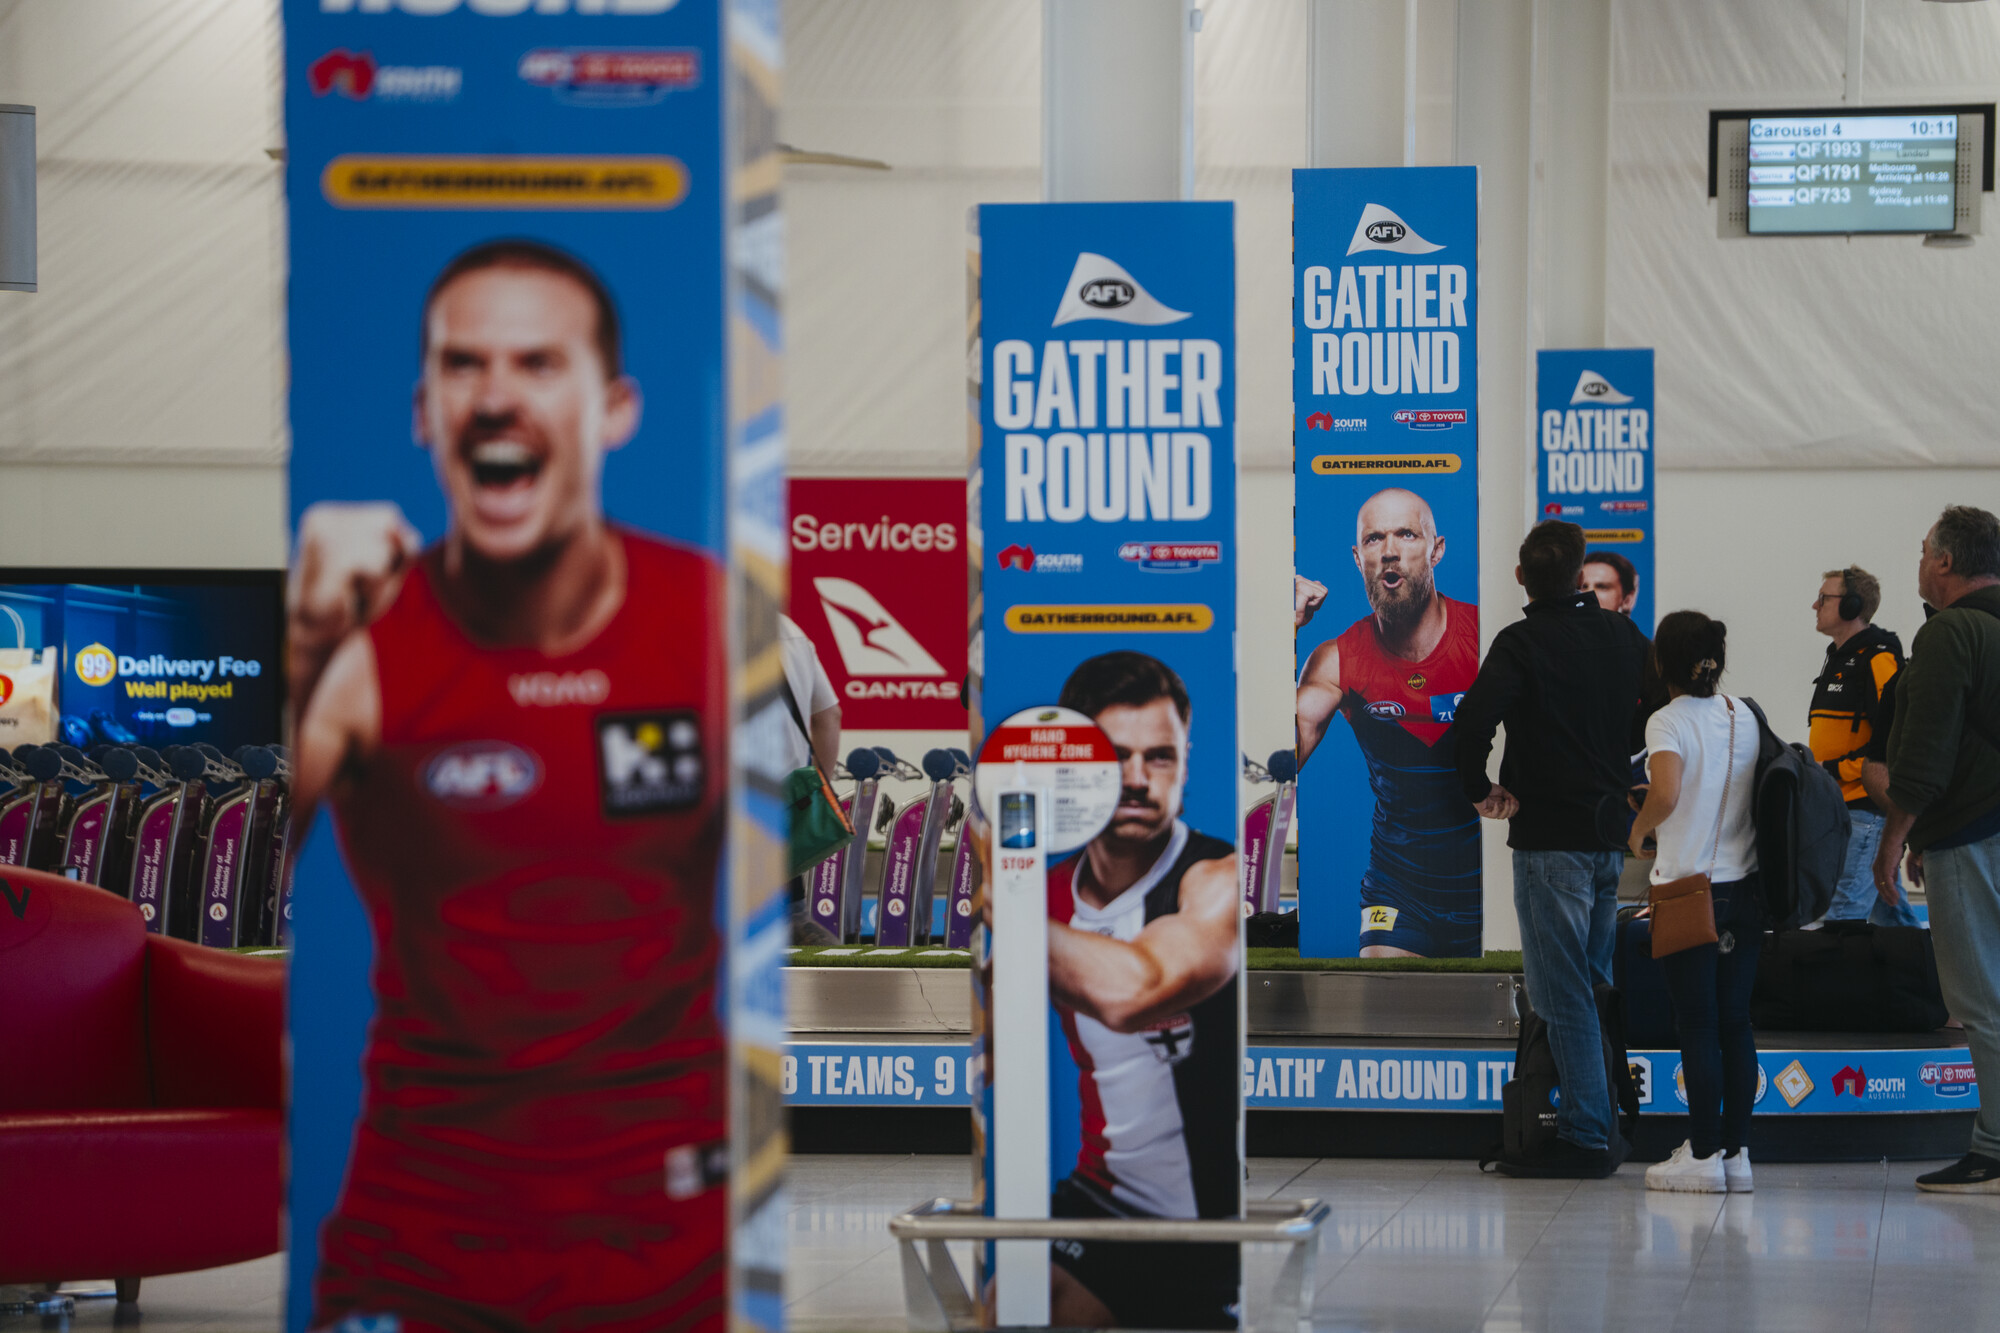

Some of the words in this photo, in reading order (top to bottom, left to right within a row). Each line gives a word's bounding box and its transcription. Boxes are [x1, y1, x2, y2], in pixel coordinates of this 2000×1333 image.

[1751, 122, 1827, 138] Carousel
[1832, 122, 1842, 136] 4
[1909, 120, 1954, 135] 10:11
[1797, 142, 1862, 159] QF1993
[1869, 140, 1903, 151] Sydney
[1897, 149, 1929, 158] Landed
[1796, 164, 1860, 181] QF1791
[1868, 163, 1917, 173] Melbourne
[1874, 173, 1912, 184] Arriving
[1913, 172, 1923, 182] at
[1796, 187, 1852, 205] QF733
[1868, 185, 1903, 196] Sydney
[1874, 195, 1911, 206] Arriving
[1913, 195, 1923, 205] at
[1369, 225, 1403, 239] AFL
[1083, 284, 1131, 303] AFL
[1304, 264, 1468, 329] GATHER
[1312, 331, 1460, 396] ROUND
[993, 338, 1223, 430] GATHER
[1334, 418, 1367, 428] SOUTH
[1394, 412, 1416, 421] AFL
[1432, 412, 1464, 420] TOYOTA
[1542, 408, 1649, 452] GATHER
[1322, 459, 1451, 470] GATHERROUND.AFL
[1548, 450, 1645, 494] ROUND
[1005, 431, 1212, 523] ROUND
[791, 513, 957, 552] Services
[1117, 544, 1149, 558] AFL
[1172, 546, 1217, 558] TOYOTA
[1036, 553, 1083, 568] SOUTH
[1019, 611, 1197, 625] GATHERROUND.AFL
[118, 654, 215, 682] Delivery
[219, 656, 261, 677] Fee
[125, 681, 167, 698] Well
[170, 681, 233, 702] played
[844, 680, 960, 699] QANTAS
[1030, 729, 1067, 743] HAND
[1003, 745, 1058, 760] HYGIENE
[1059, 744, 1094, 760] ZONE
[152, 838, 162, 865] Airport
[224, 838, 234, 865] Airport
[902, 836, 912, 863] Airport
[1001, 857, 1035, 870] STOP
[140, 864, 151, 898] Courtesy
[148, 865, 159, 899] Adelaide
[211, 864, 223, 898] Courtesy
[220, 865, 231, 899] Adelaide
[889, 861, 901, 894] Courtesy
[897, 861, 909, 895] Adelaide
[958, 861, 970, 894] Courtesy
[808, 1055, 925, 1101] TEAMS,
[934, 1055, 955, 1096] 9
[1335, 1058, 1467, 1101] AROUND
[1920, 1067, 1941, 1080] AFL
[1868, 1077, 1905, 1092] SOUTH
[1868, 1092, 1906, 1100] AUSTRALIA
